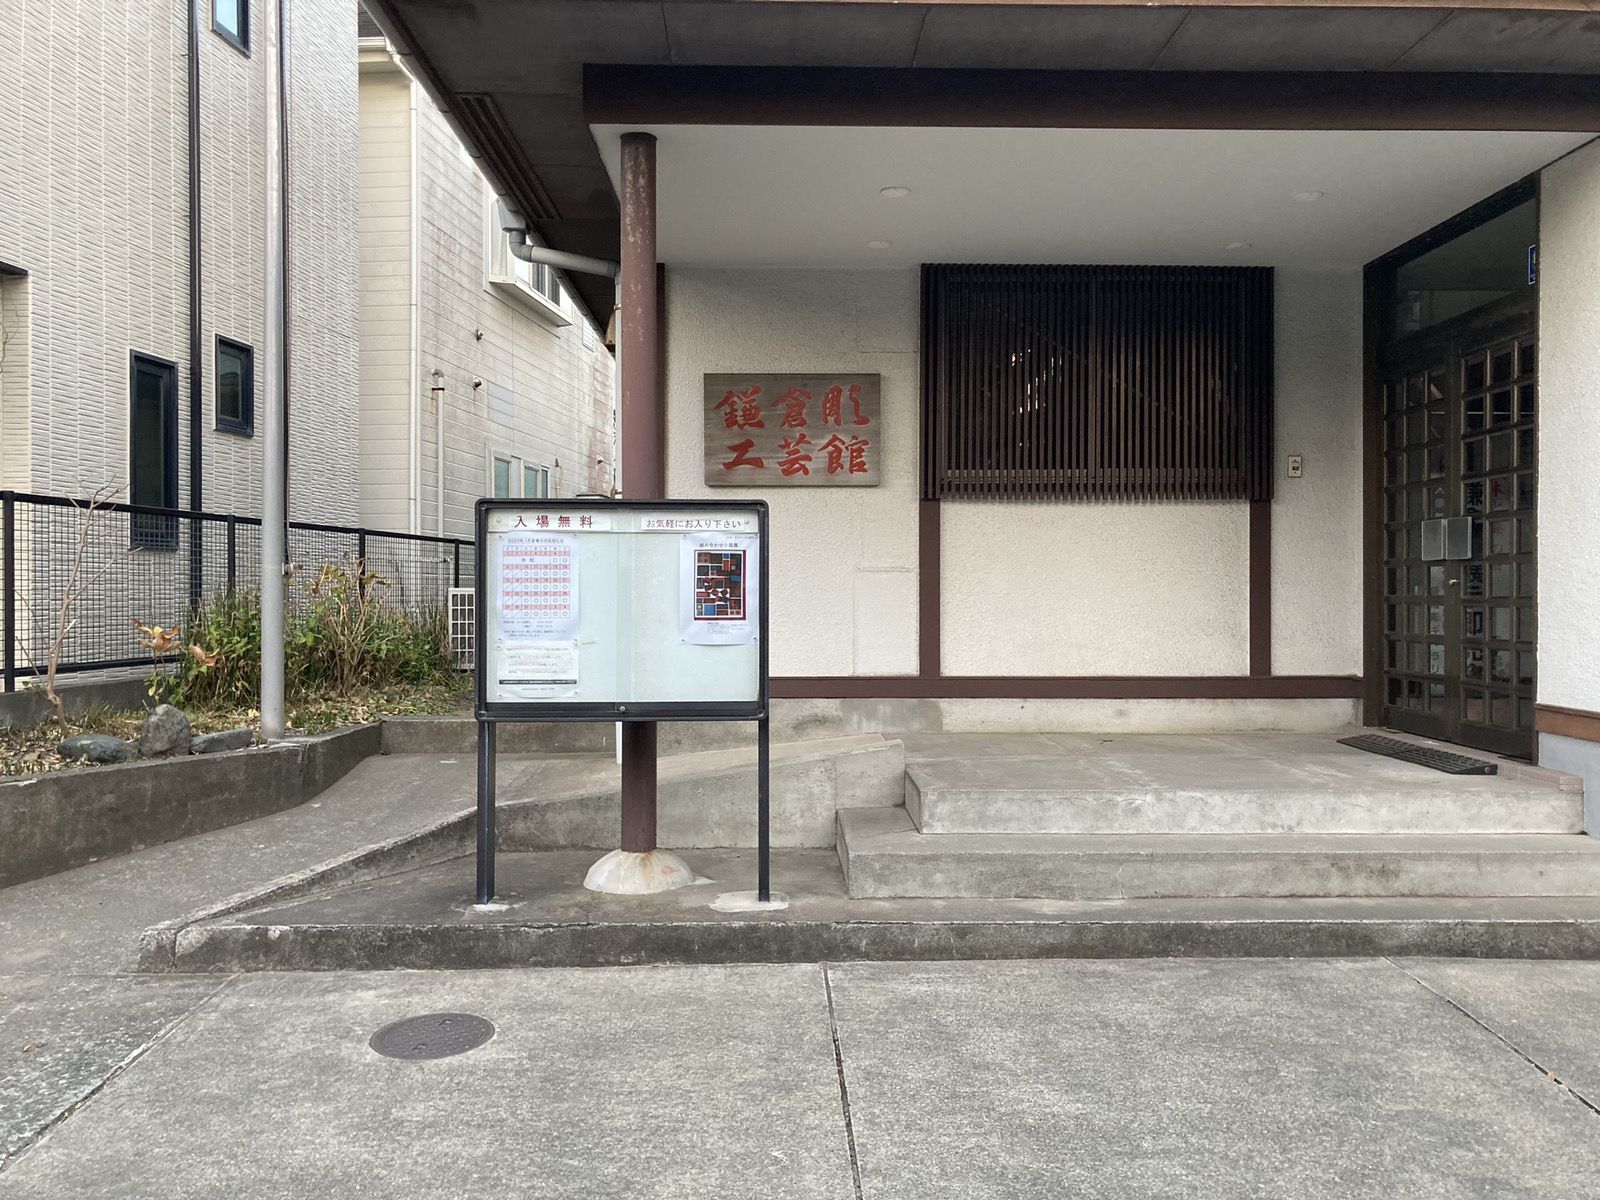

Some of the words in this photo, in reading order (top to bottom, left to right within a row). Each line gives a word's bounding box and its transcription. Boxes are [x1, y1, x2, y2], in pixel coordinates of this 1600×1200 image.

[713, 384, 871, 430] 鎌倉彫
[722, 432, 871, 477] 工芸館
[514, 515, 593, 528] 入場無料
[646, 519, 741, 529] お気軽にお入り下さい
